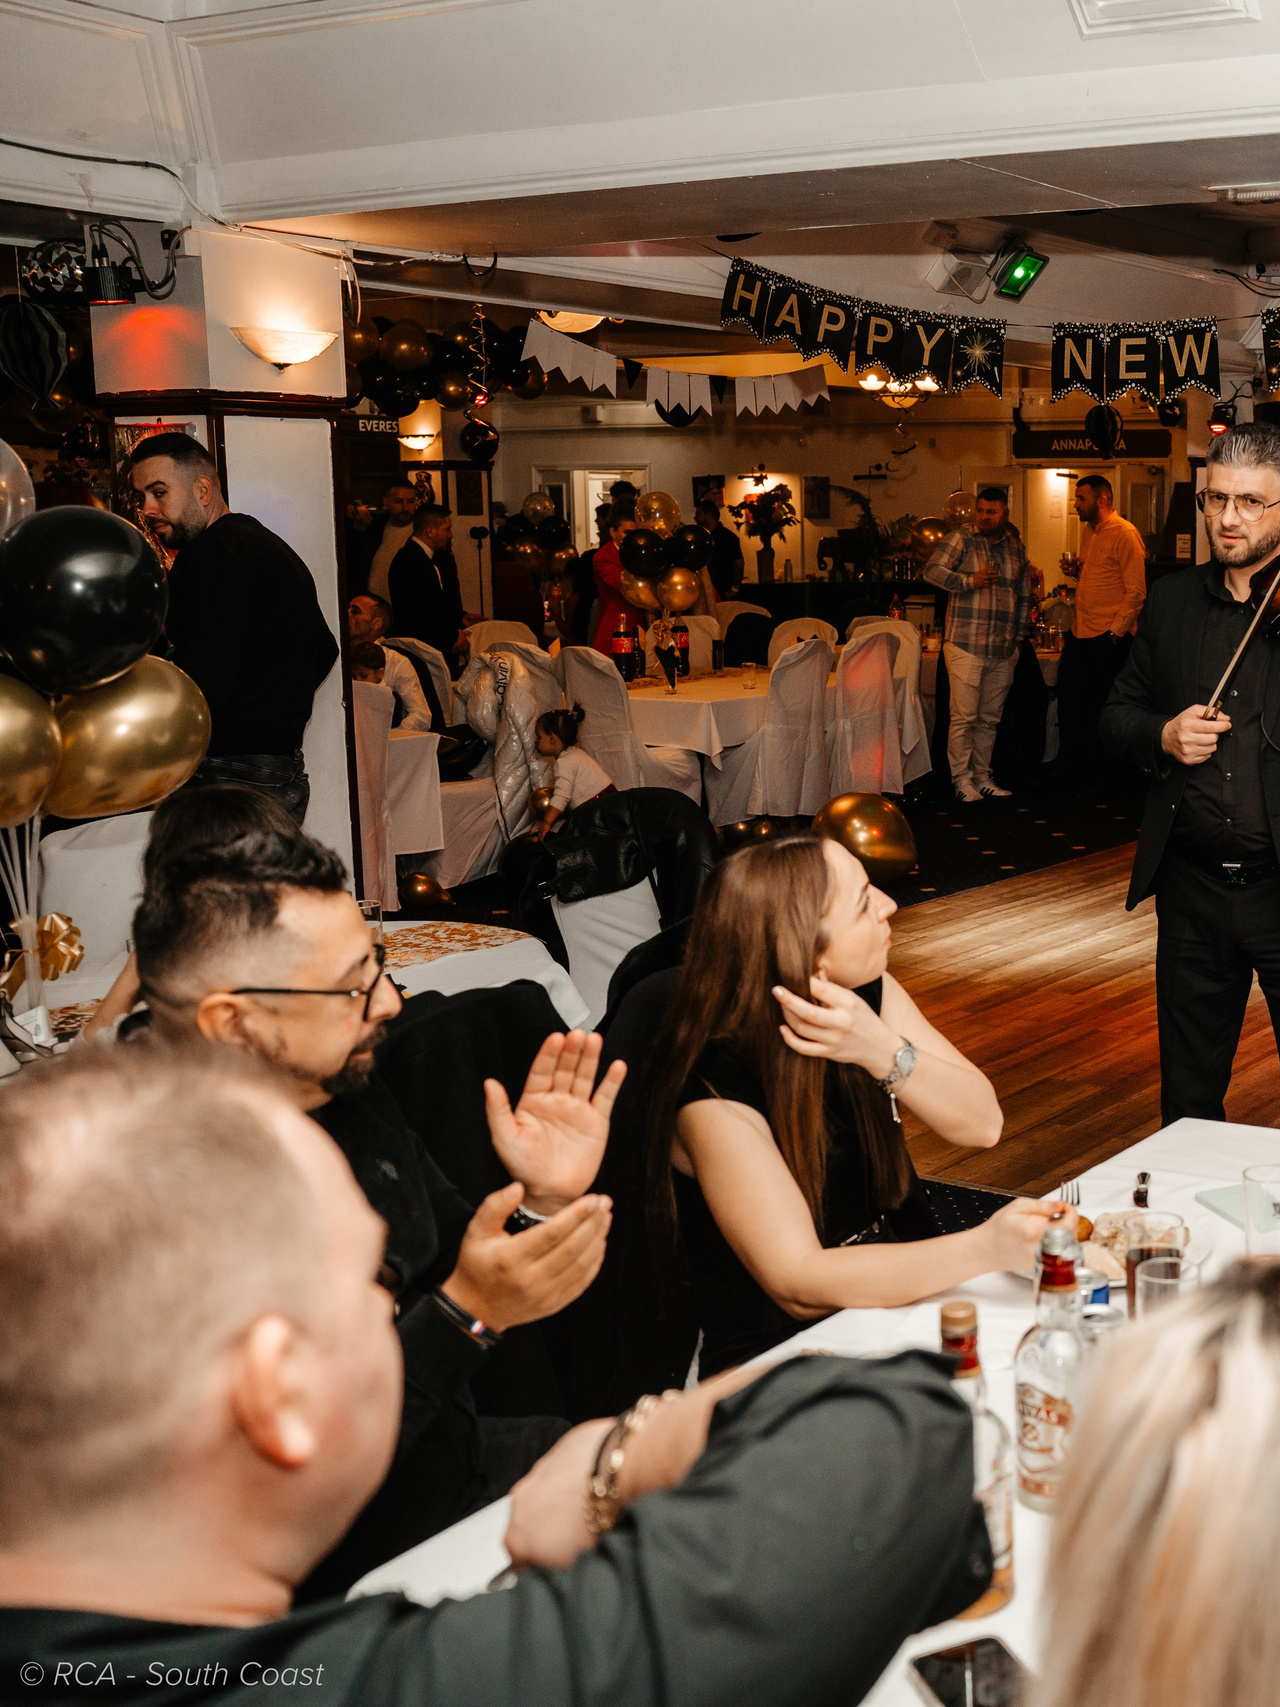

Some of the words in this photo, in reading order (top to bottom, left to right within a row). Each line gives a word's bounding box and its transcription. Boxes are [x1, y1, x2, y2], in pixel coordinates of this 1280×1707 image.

[732, 273, 946, 367] HAPPY
[1063, 332, 1212, 381] NEW
[359, 419, 399, 433] EVERES
